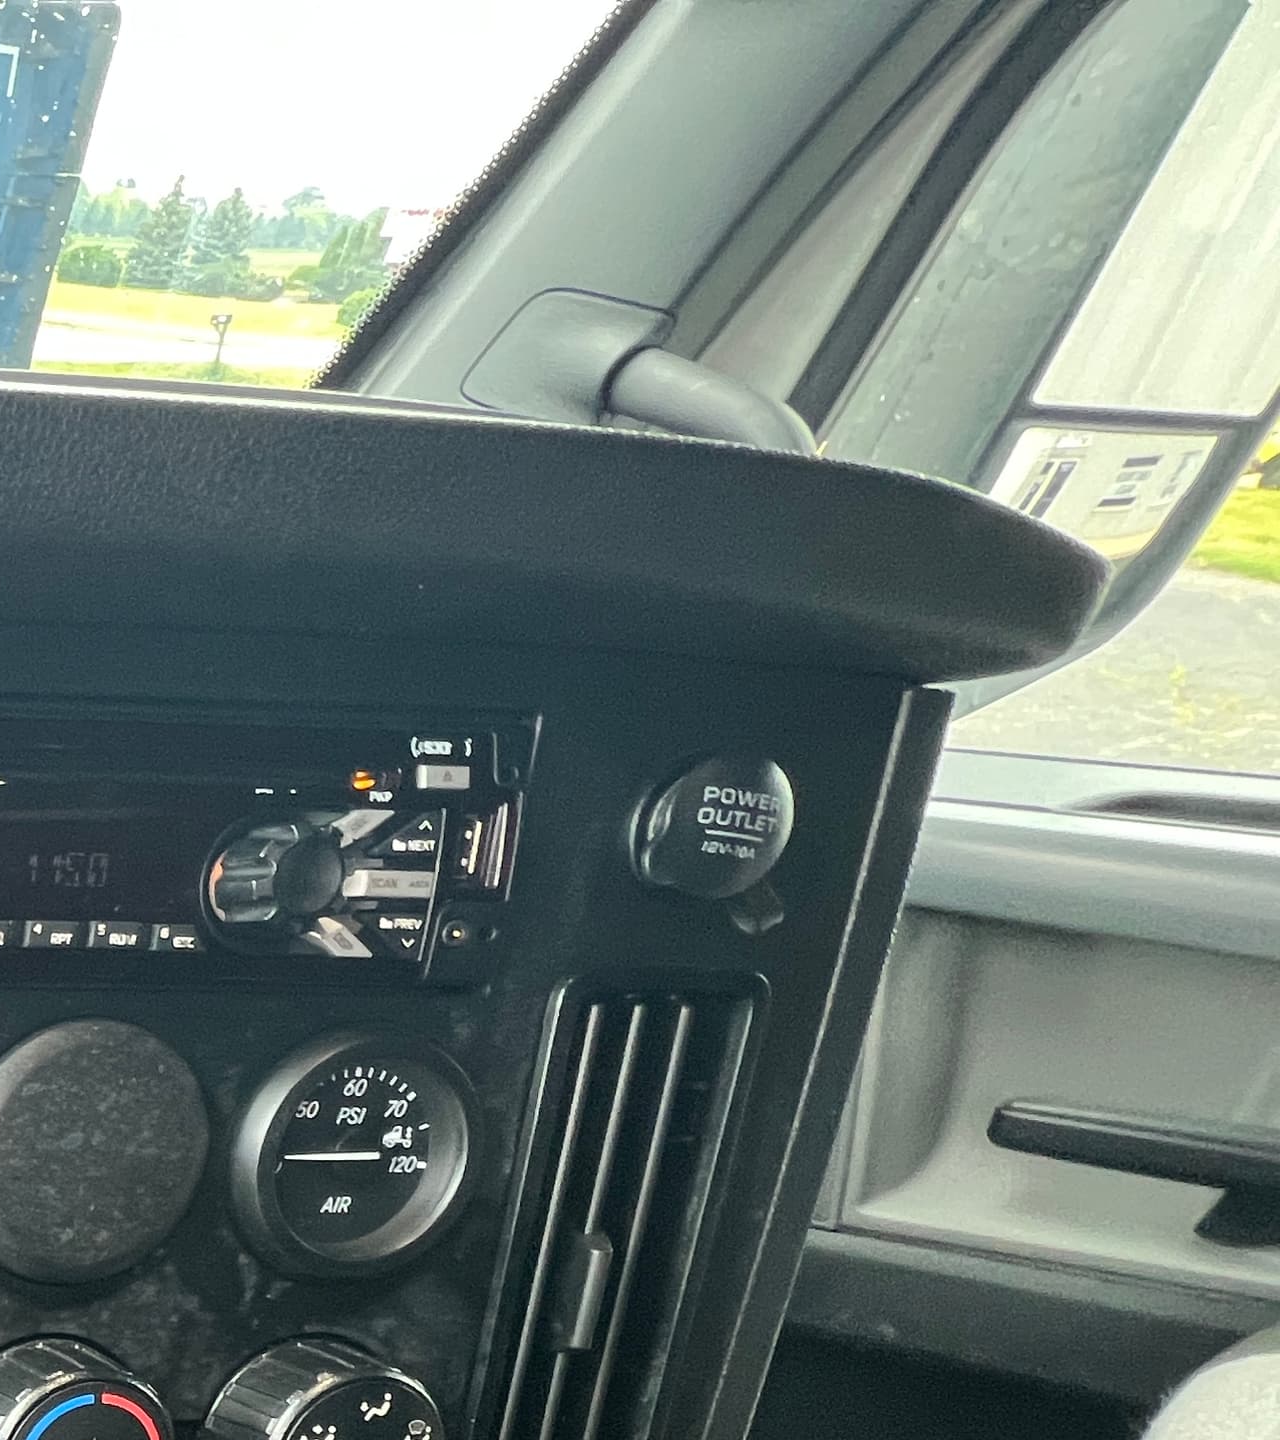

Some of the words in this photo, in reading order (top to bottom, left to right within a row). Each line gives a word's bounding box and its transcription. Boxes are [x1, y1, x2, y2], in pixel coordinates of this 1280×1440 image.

[703, 786, 781, 811] POWER
[697, 807, 778, 833] OUTLET
[32, 923, 42, 935] 4
[97, 923, 106, 936] 5
[160, 926, 170, 939] 6
[343, 1079, 367, 1096] 60
[295, 1101, 320, 1118] 50
[336, 1108, 366, 1125] PSI
[384, 1100, 408, 1117] 70
[389, 1156, 416, 1173] 120
[320, 1197, 352, 1213] AIR
